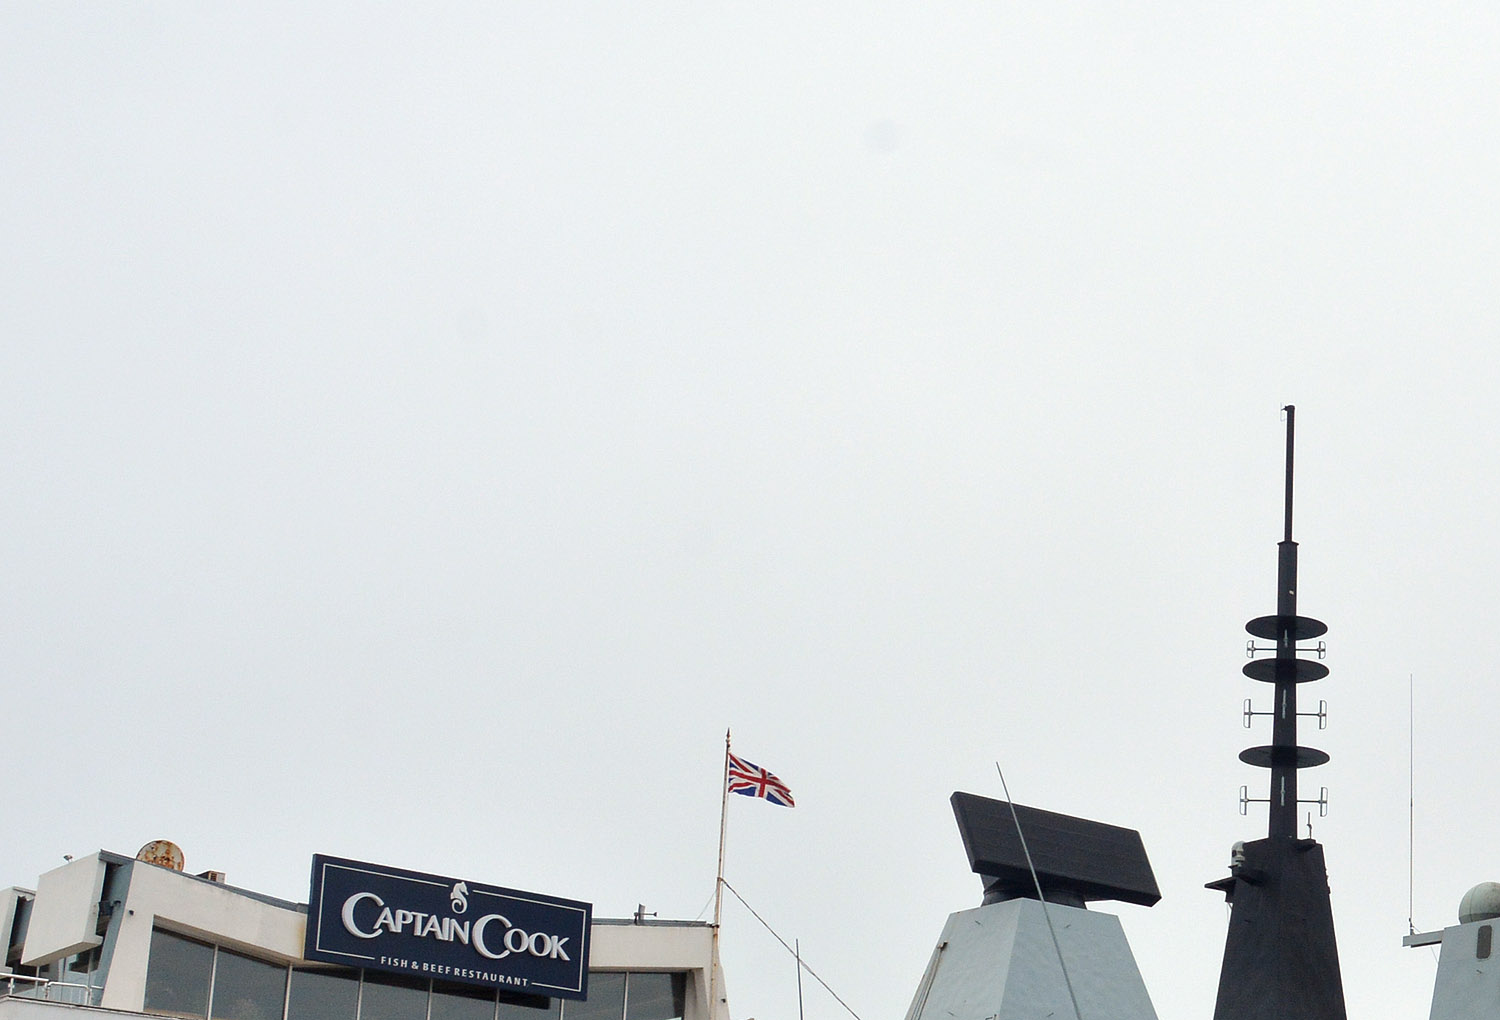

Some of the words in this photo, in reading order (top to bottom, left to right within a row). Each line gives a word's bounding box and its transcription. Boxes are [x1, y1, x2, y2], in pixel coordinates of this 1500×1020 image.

[341, 891, 471, 945] CAPTAIN
[471, 913, 571, 962] COOK
[380, 955, 408, 969] FISH
[411, 961, 419, 970] &
[422, 962, 451, 975] BEEF
[454, 967, 528, 988] RESTAURANT
